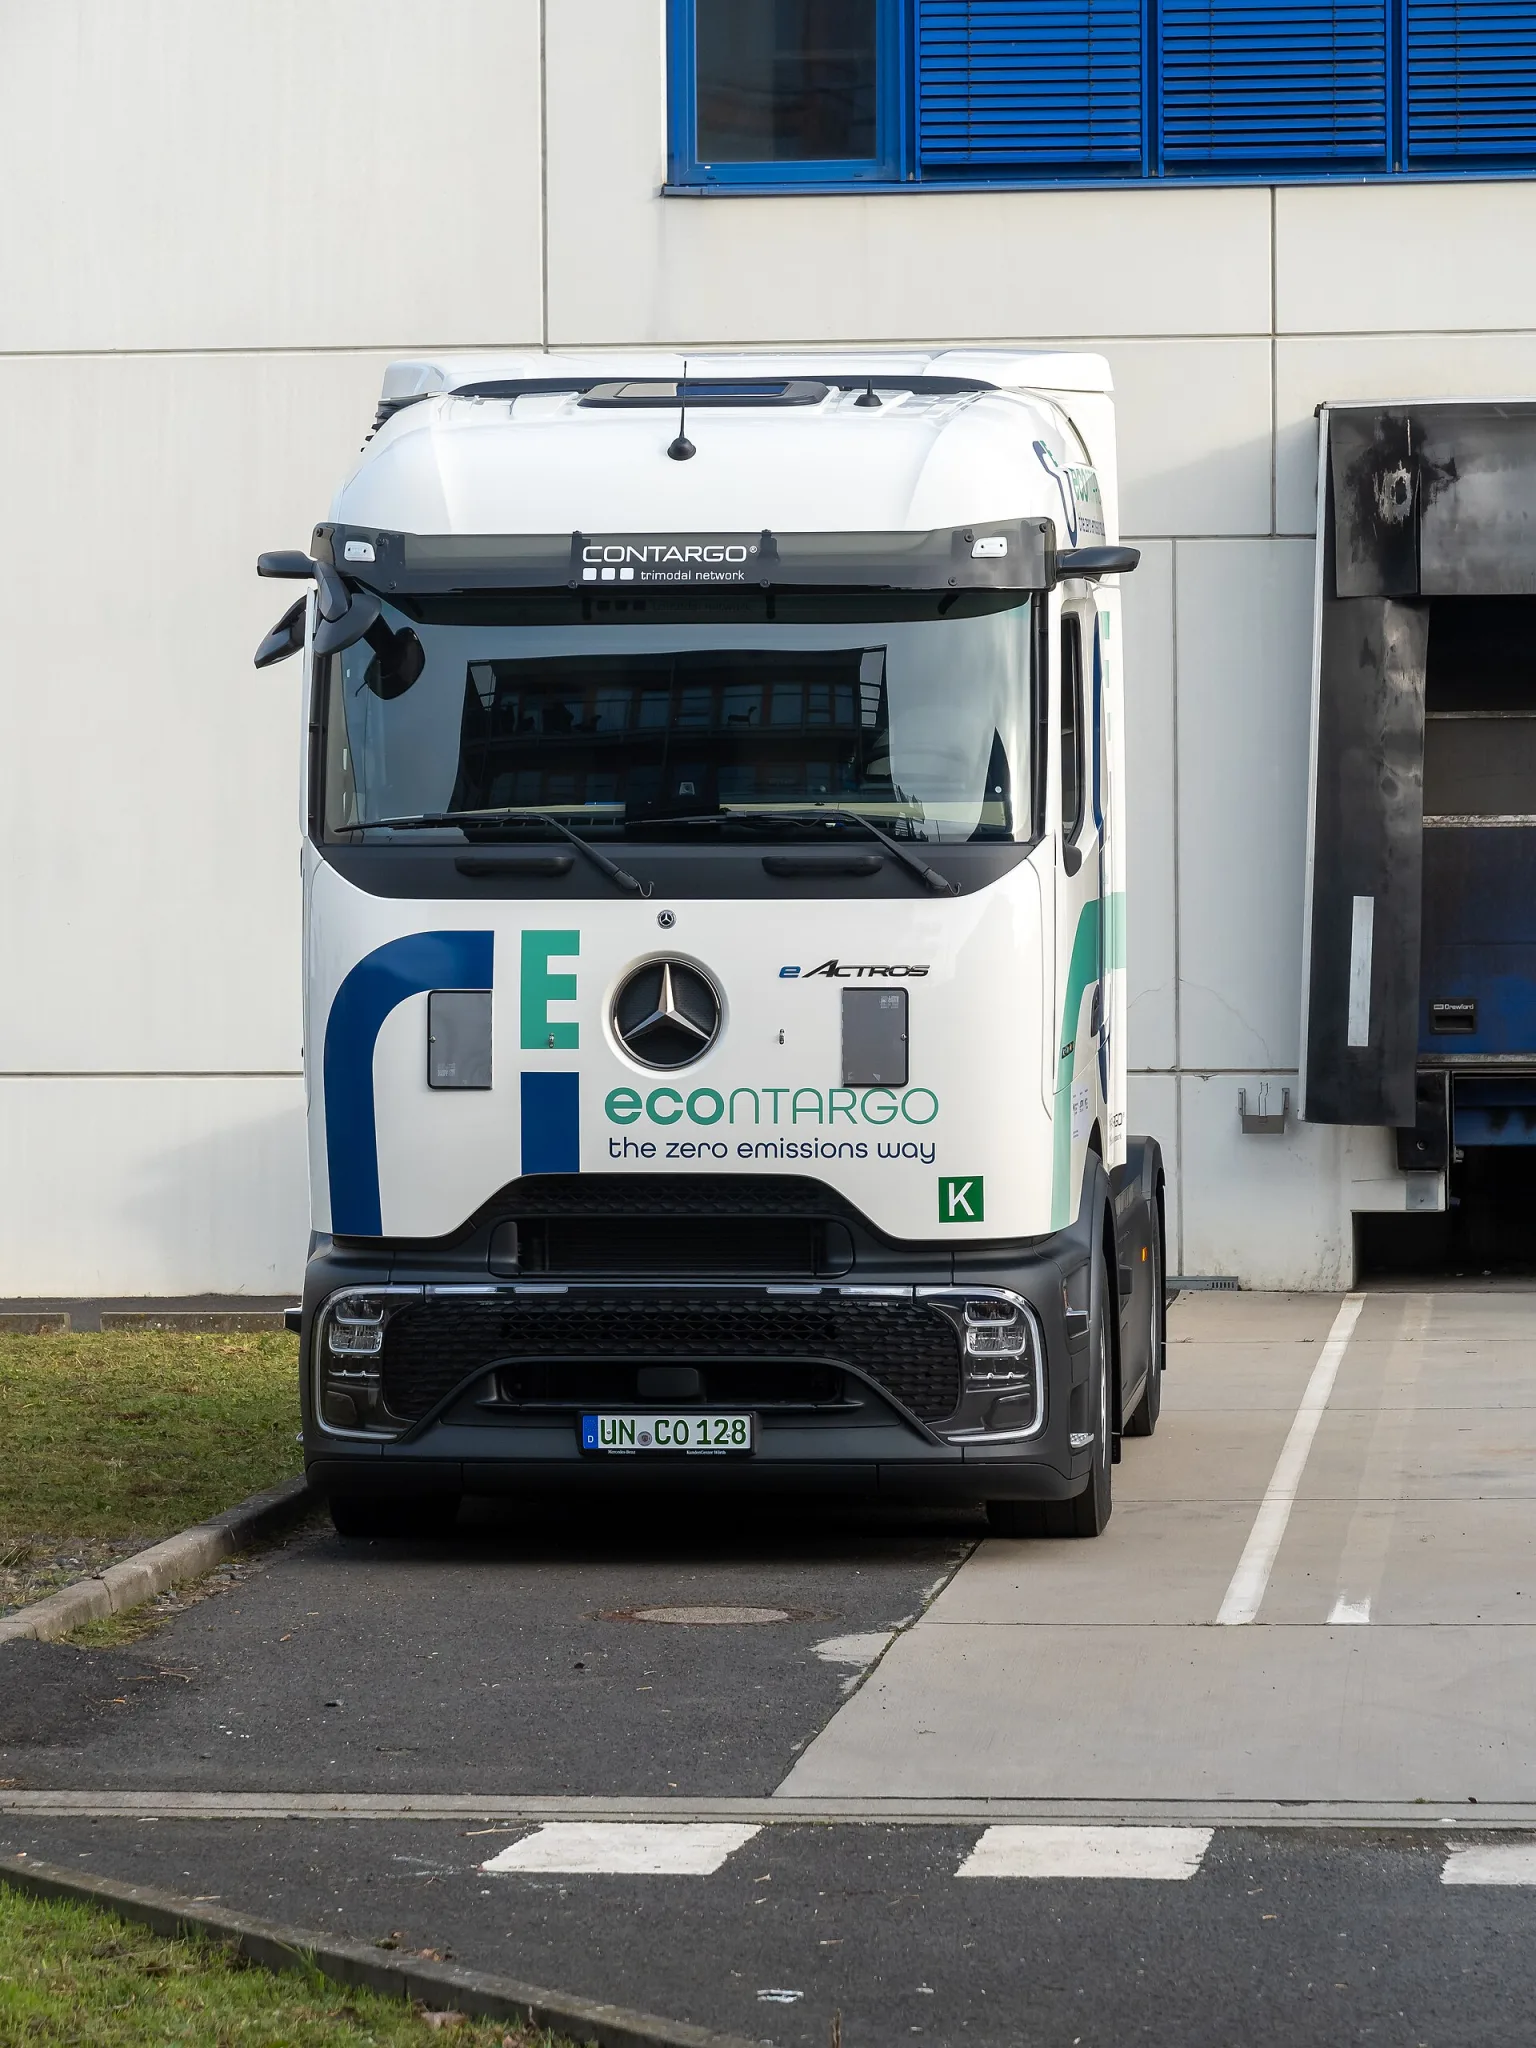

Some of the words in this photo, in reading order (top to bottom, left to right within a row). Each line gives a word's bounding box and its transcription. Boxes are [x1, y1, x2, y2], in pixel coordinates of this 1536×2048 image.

[640, 569, 692, 581] trimodal
[695, 571, 745, 581] network
[608, 1136, 657, 1159] the
[665, 1141, 729, 1159] zero
[736, 1137, 869, 1159] emissions
[876, 1142, 937, 1165] way
[947, 1181, 976, 1217] K
[587, 1435, 594, 1443] D
[600, 1419, 636, 1445] UN
[654, 1419, 690, 1445] CO
[696, 1419, 747, 1445] 128
